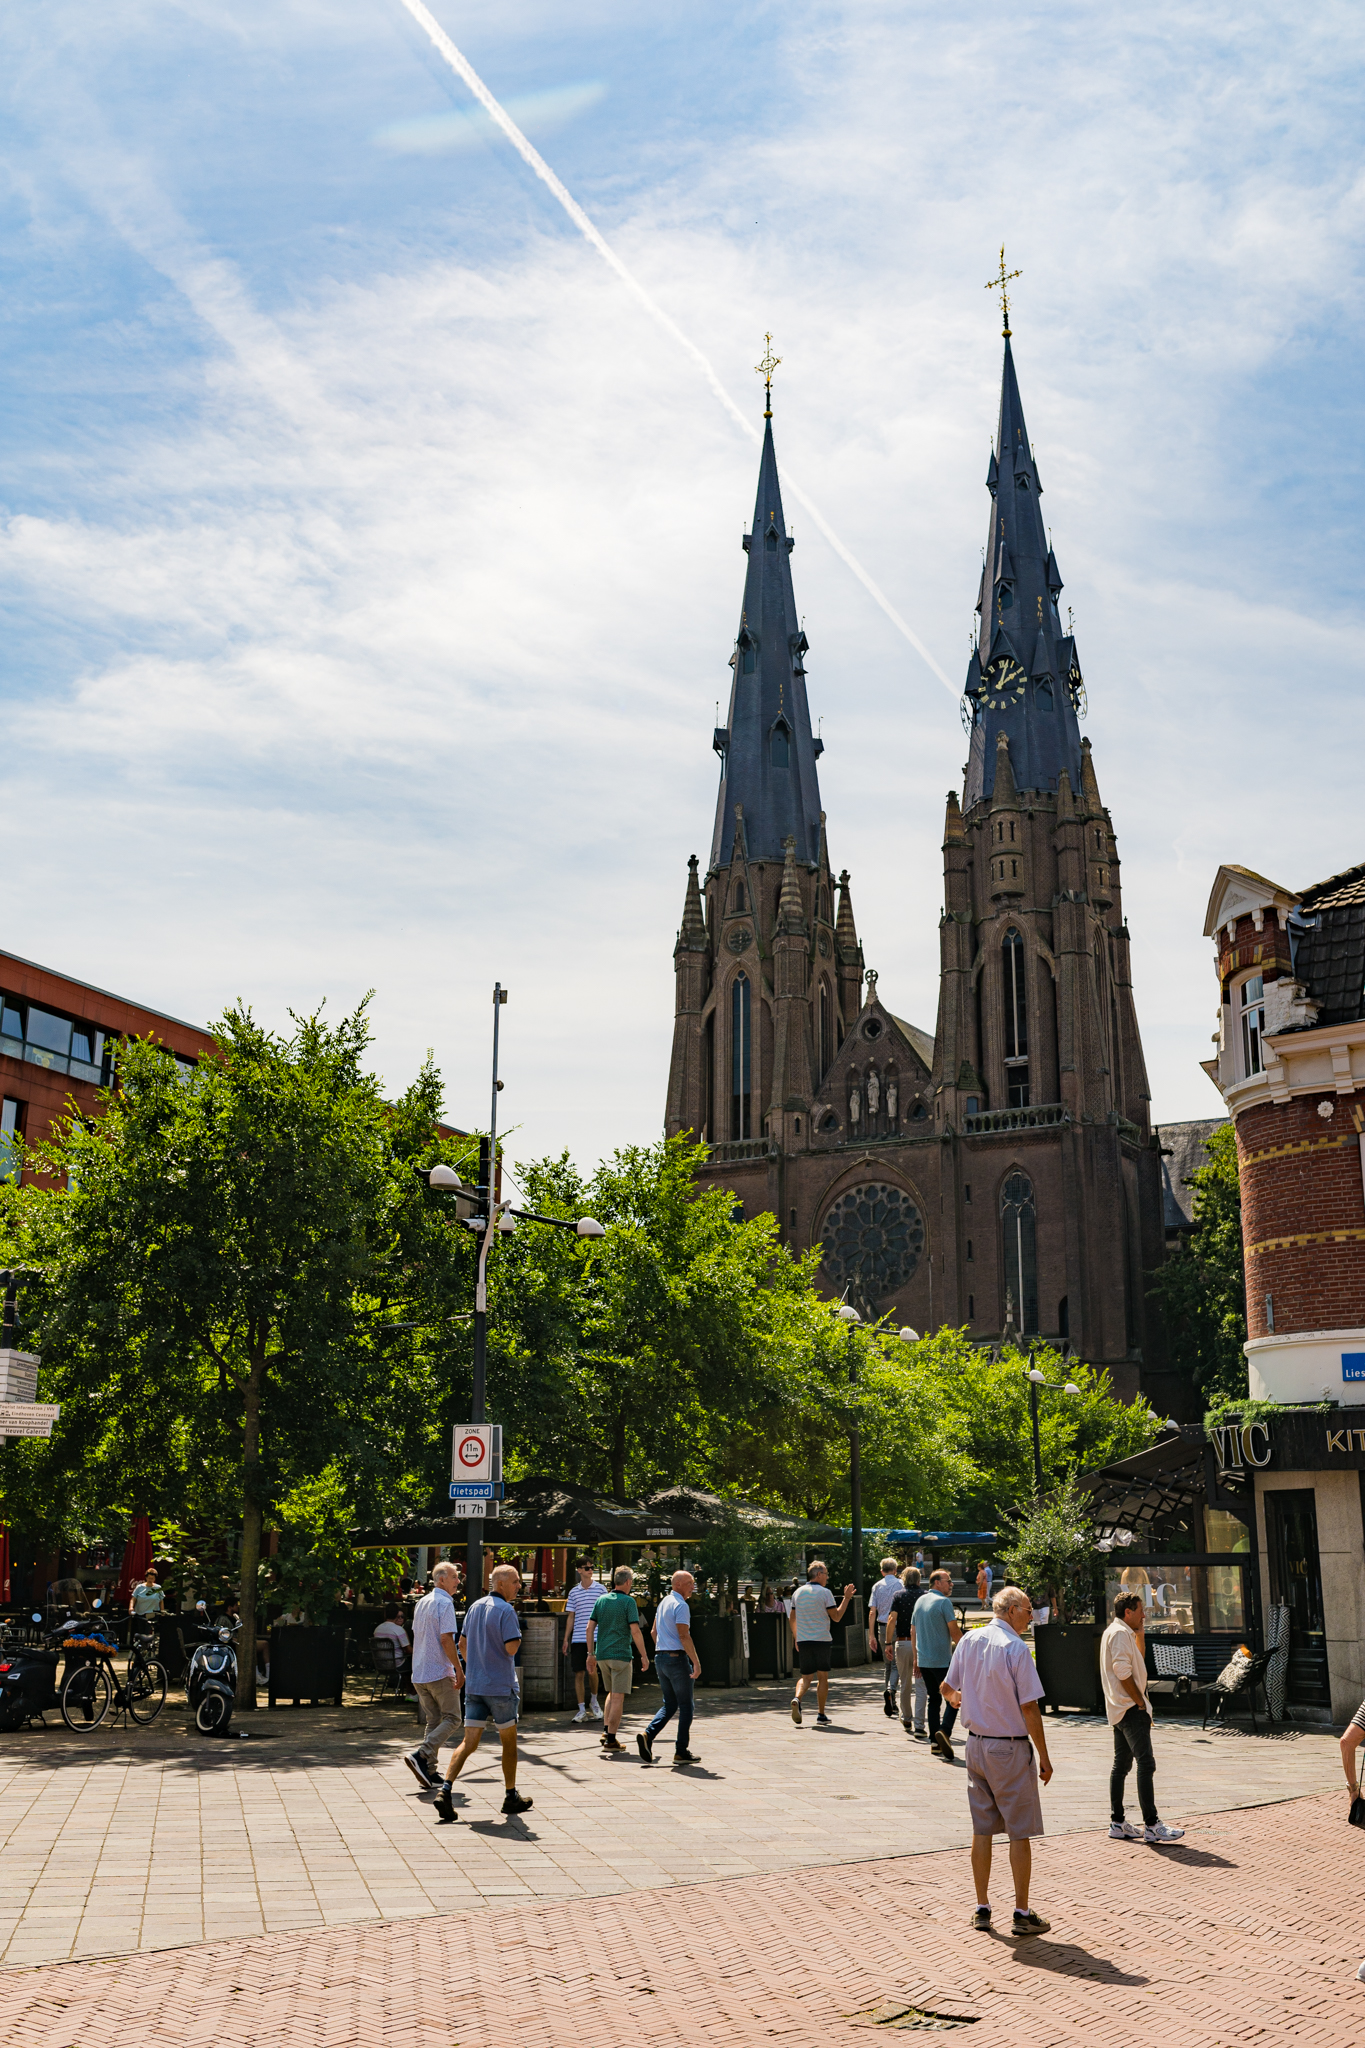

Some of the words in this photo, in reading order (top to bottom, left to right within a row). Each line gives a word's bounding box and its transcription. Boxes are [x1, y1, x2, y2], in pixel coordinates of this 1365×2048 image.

[1209, 1422, 1271, 1468] VIC
[1326, 1429, 1365, 1452] KIT
[453, 1487, 489, 1496] fietspad
[1288, 1560, 1308, 1575] VIC
